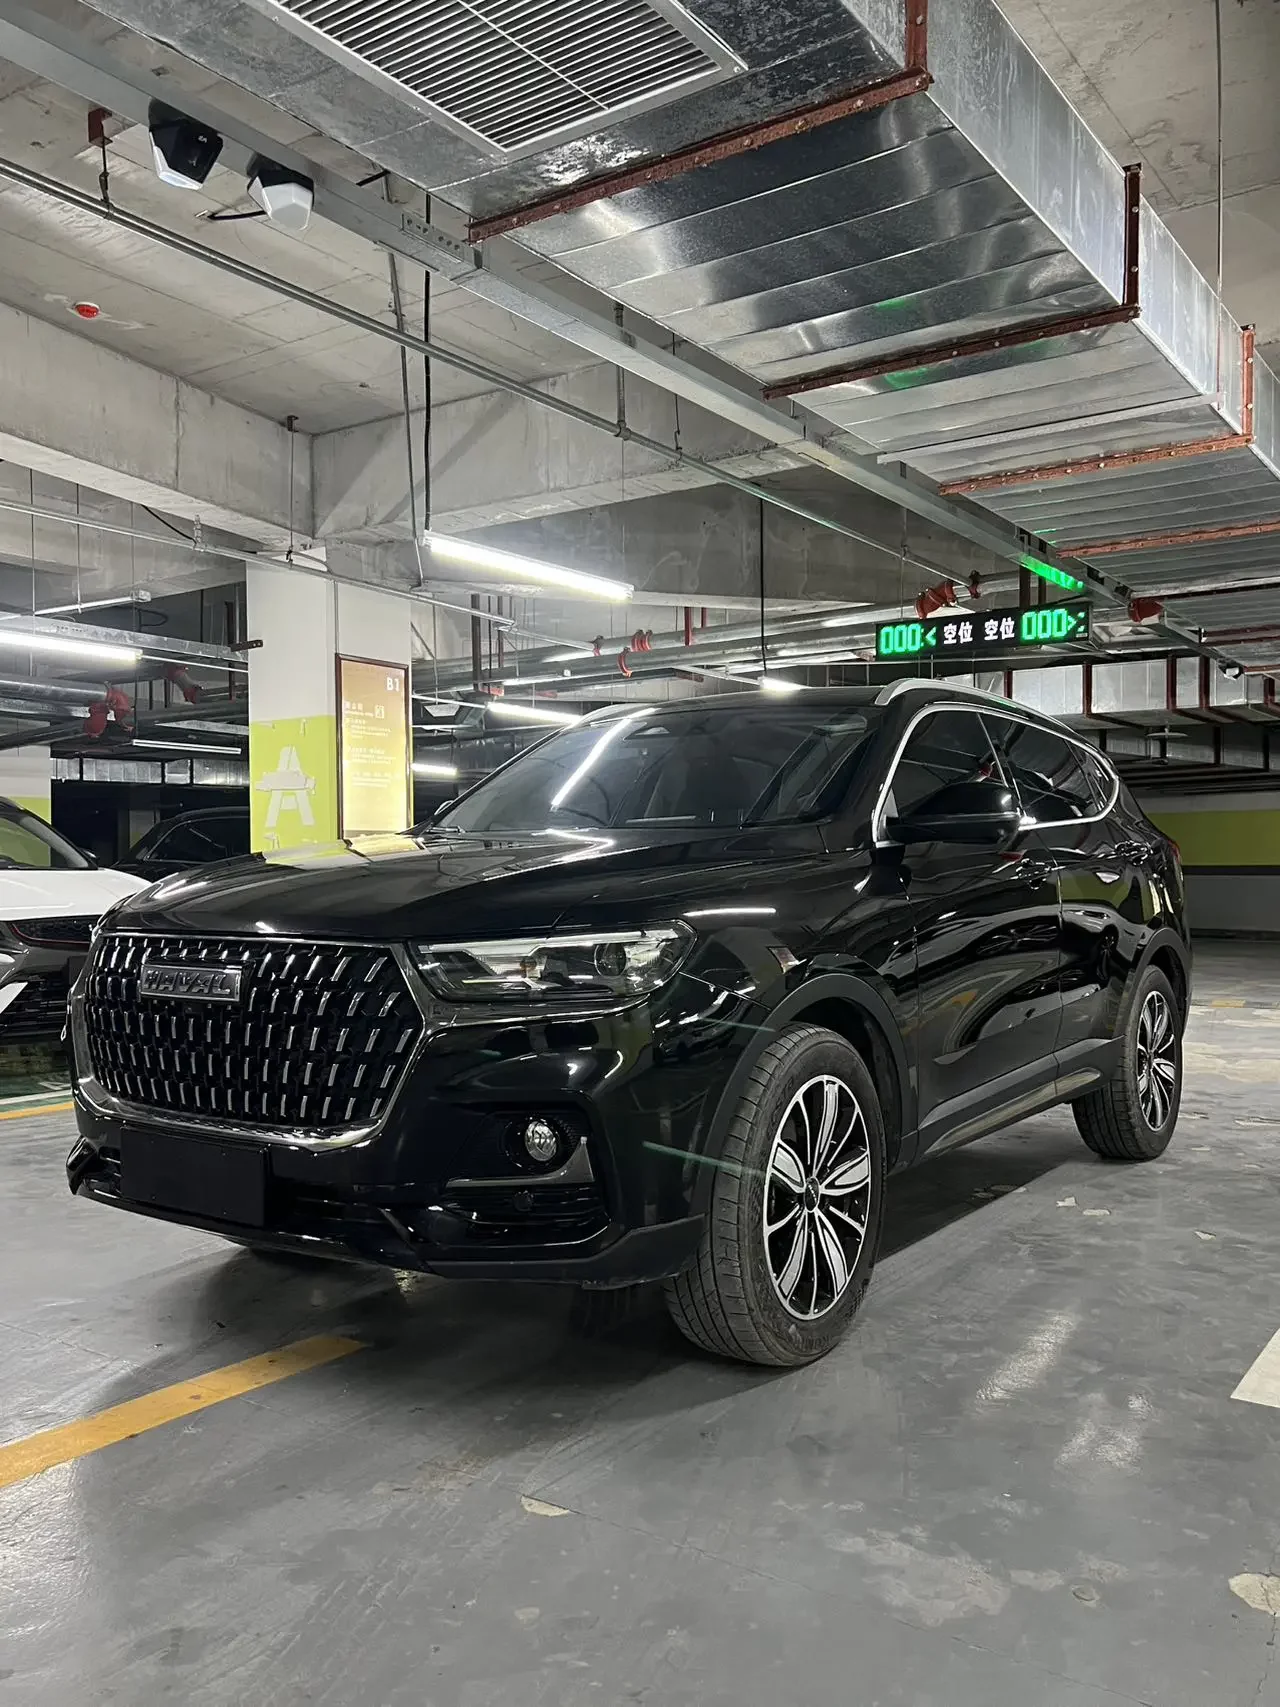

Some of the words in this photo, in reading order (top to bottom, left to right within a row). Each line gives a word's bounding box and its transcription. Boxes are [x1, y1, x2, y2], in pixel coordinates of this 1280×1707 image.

[880, 623, 921, 654] 000
[943, 621, 973, 644] 空位
[984, 617, 1015, 640] 空位
[1022, 608, 1067, 640] 000
[386, 677, 400, 692] B1
[142, 970, 231, 994] HAVAL
